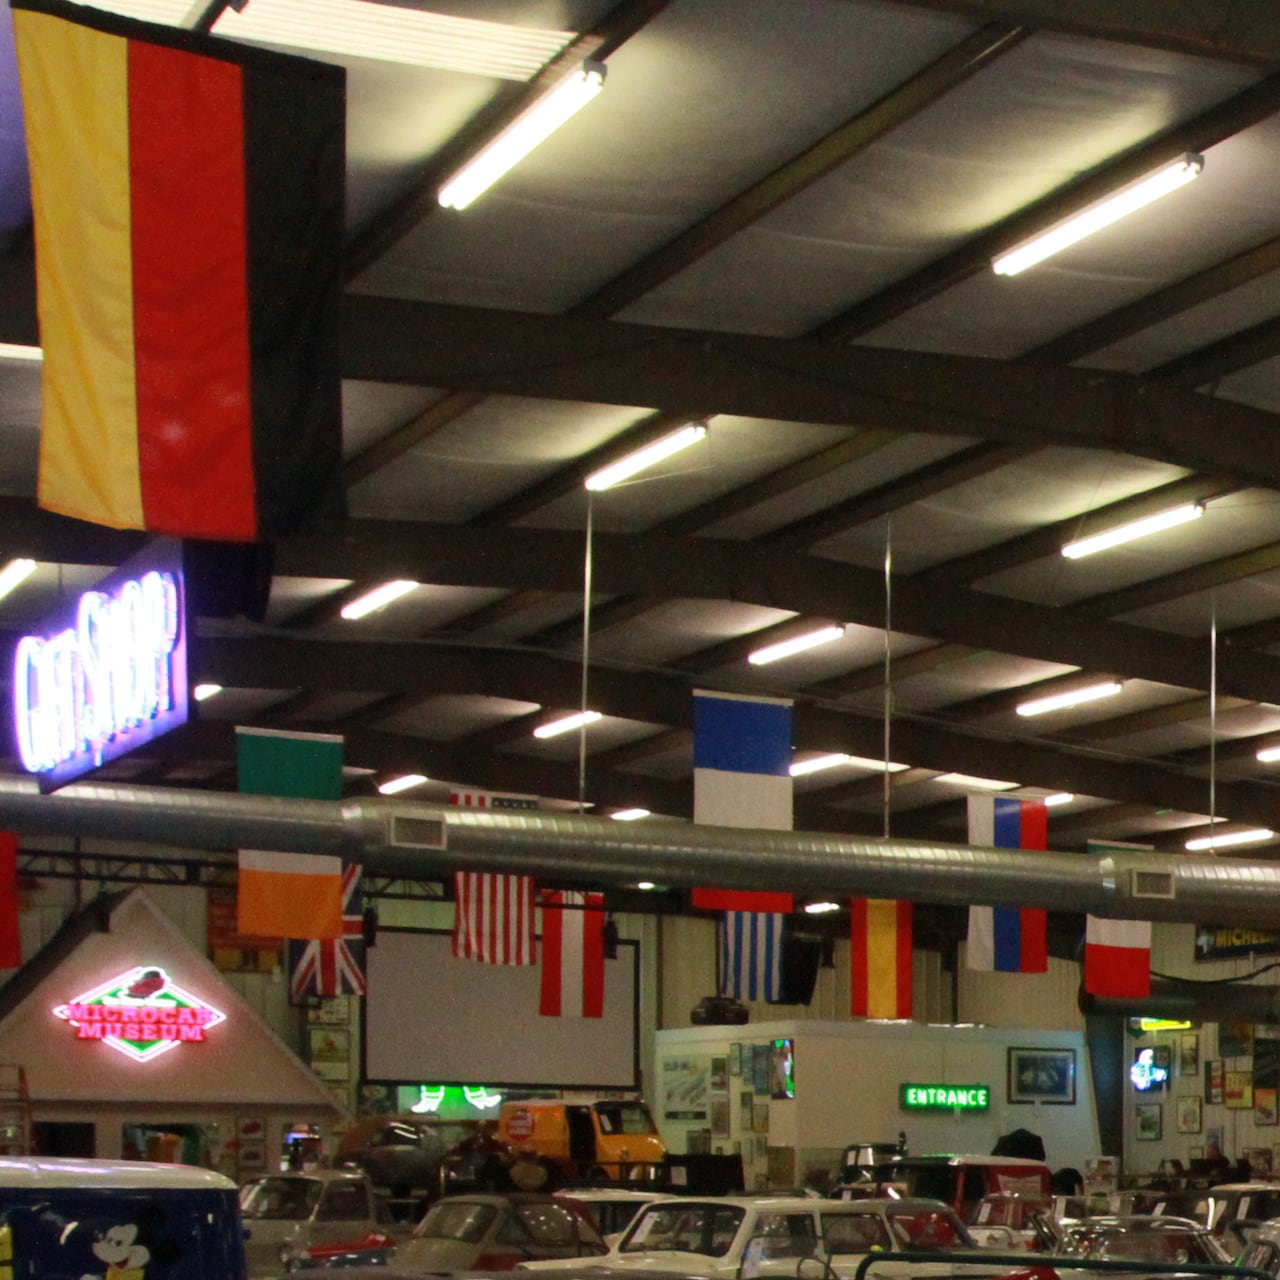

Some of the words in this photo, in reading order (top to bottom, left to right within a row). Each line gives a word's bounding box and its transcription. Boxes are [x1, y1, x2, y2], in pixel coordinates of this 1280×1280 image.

[68, 1004, 213, 1024] MICROCAR
[78, 1022, 204, 1040] MUSEUM
[907, 1088, 987, 1106] ENTRANCE
